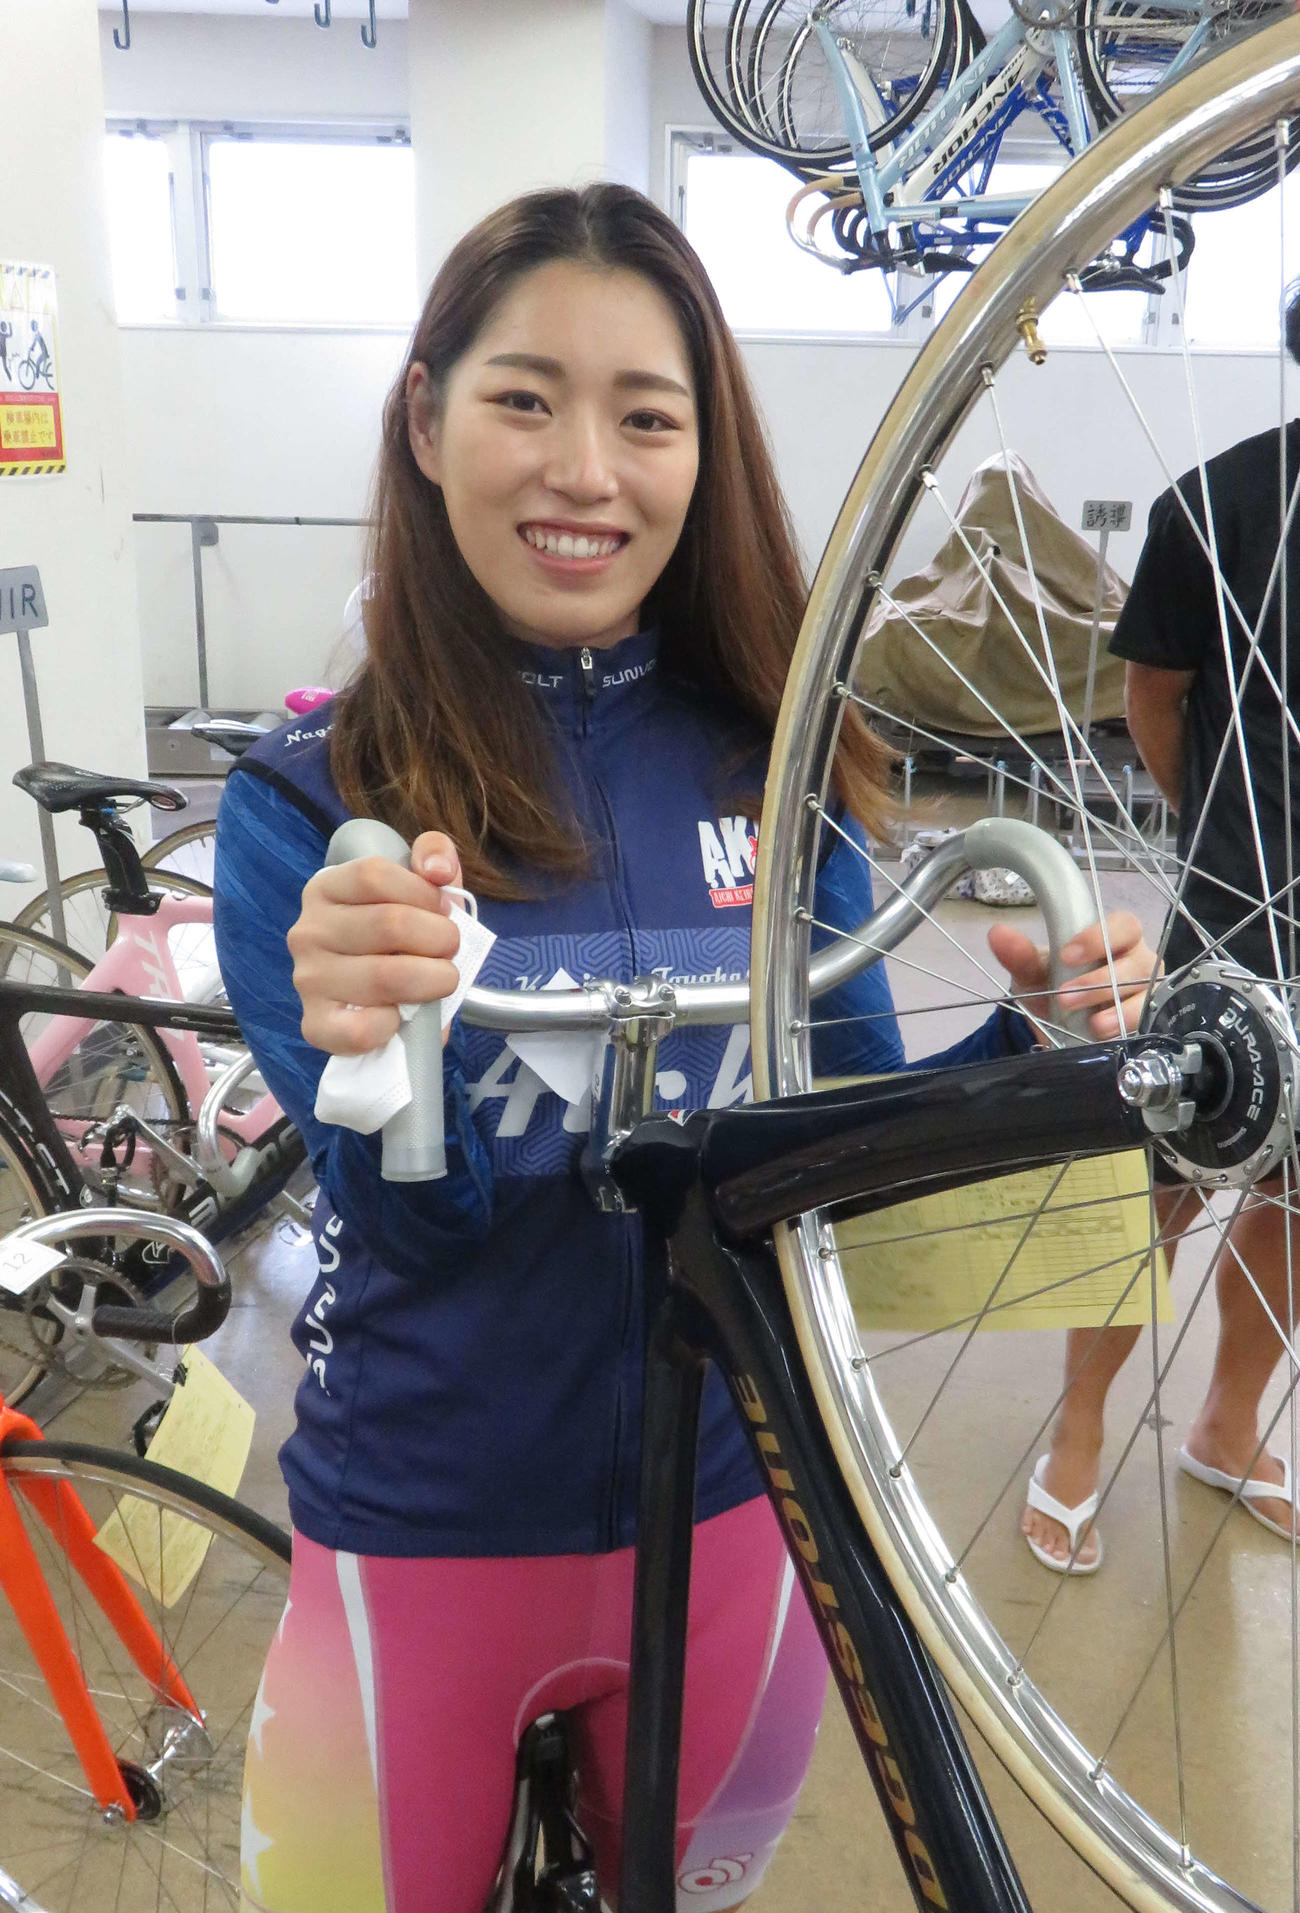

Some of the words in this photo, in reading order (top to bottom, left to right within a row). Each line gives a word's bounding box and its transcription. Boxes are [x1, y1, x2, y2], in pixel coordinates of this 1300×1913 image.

[932, 61, 1025, 176] ANCHOR
[935, 105, 1012, 196] ANCHOR
[1221, 1007, 1266, 1122] DURA-ACE
